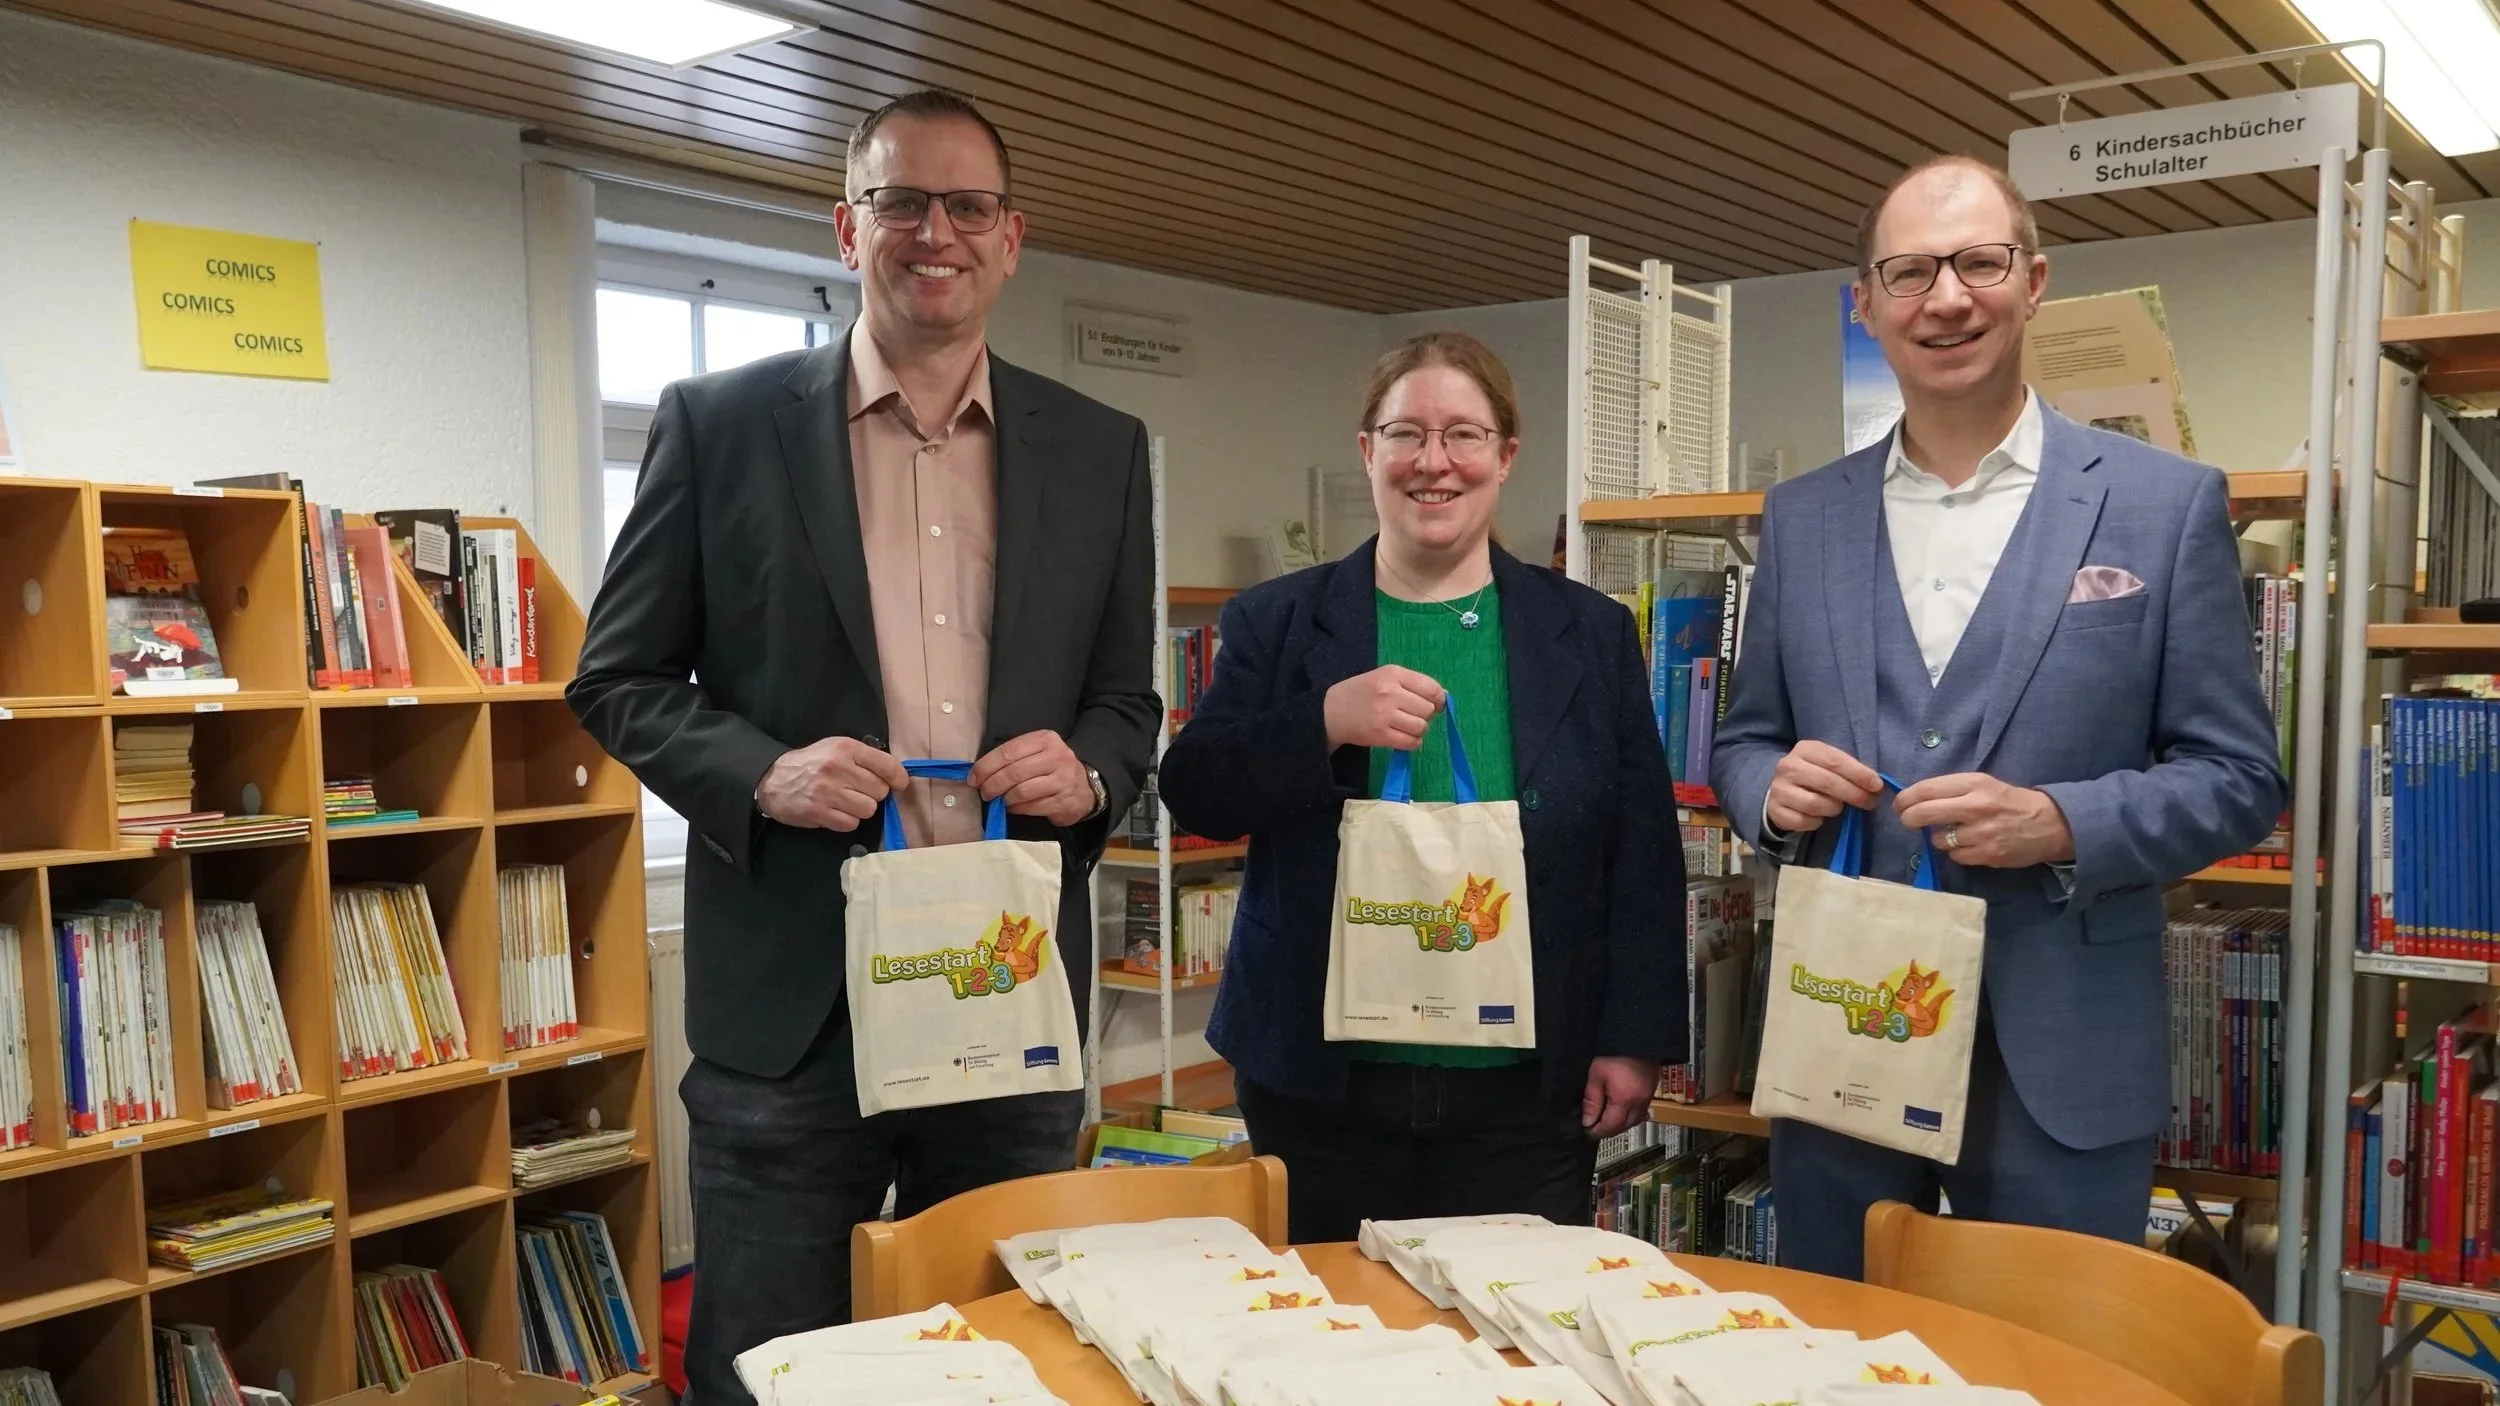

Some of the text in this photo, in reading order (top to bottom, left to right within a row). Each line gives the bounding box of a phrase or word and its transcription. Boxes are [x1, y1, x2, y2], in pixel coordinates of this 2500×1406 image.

[2070, 116, 2306, 162] 6 Kindersachbücher
[2095, 153, 2208, 182] Schulalter
[206, 258, 276, 281] COMICS
[162, 292, 235, 314] COMICS
[234, 333, 303, 353] COMICS
[1102, 348, 1115, 357] von
[1137, 351, 1160, 364] Jahren
[1148, 341, 1156, 350] für
[1159, 342, 1182, 354] Kinder
[1724, 573, 1737, 617] STAR
[524, 587, 536, 658] Kinderland
[1720, 614, 1735, 662] WARS
[2382, 806, 2392, 860] ELEFANTEN
[1349, 898, 1455, 924] Lesestart
[1723, 886, 1753, 925] Gene
[1417, 924, 1475, 948] 1-2-3
[875, 945, 988, 979] Lesestart
[952, 965, 1012, 994] 1-2-3
[1793, 966, 1889, 1008] Lesestart
[1849, 1007, 1909, 1037] 1-2-3
[883, 1075, 930, 1087] www.lesestart.de
[1755, 1244, 1764, 1262] BUCH
